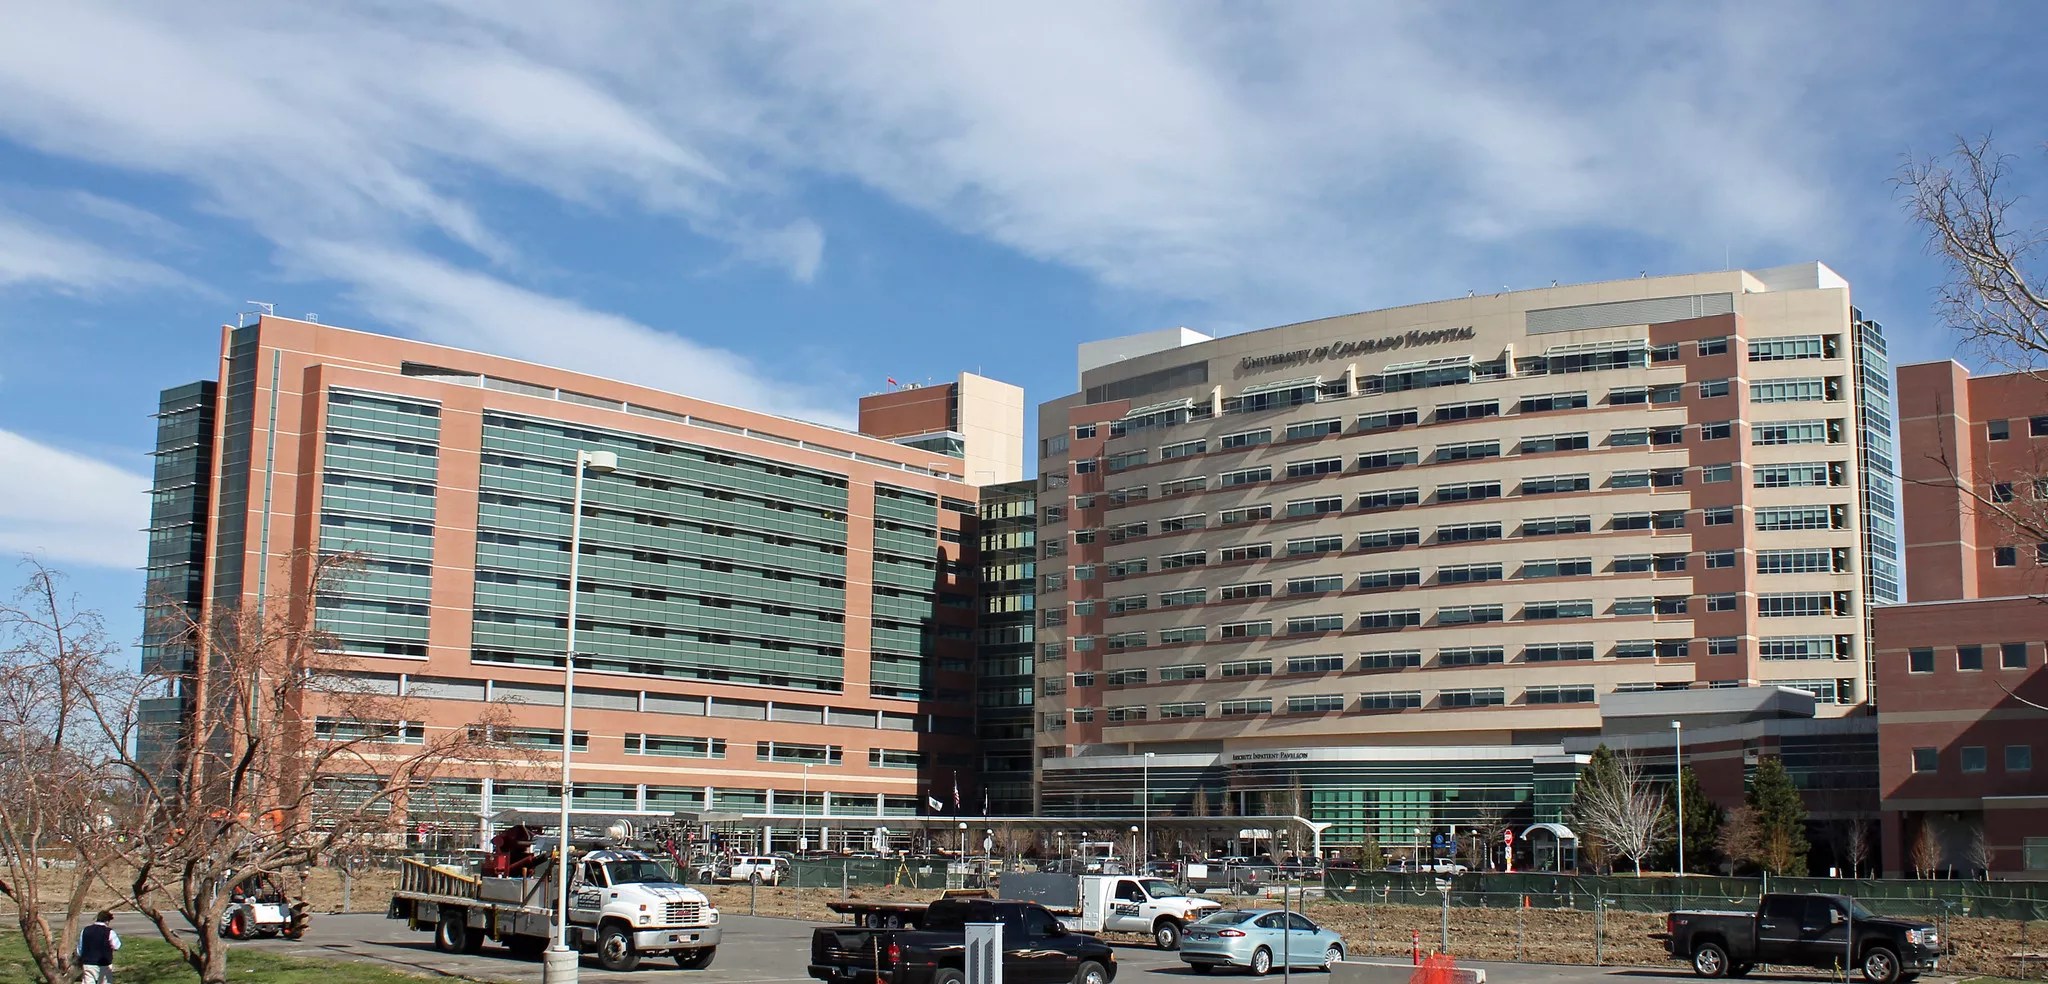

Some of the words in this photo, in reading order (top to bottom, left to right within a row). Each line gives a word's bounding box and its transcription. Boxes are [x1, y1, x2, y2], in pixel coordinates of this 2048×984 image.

[1242, 349, 1311, 369] UNIVERSITY
[1314, 346, 1329, 358] OF
[1333, 334, 1404, 355] COLORADO
[1407, 326, 1476, 345] HOSPITAL
[1281, 752, 1308, 760] PAVILION
